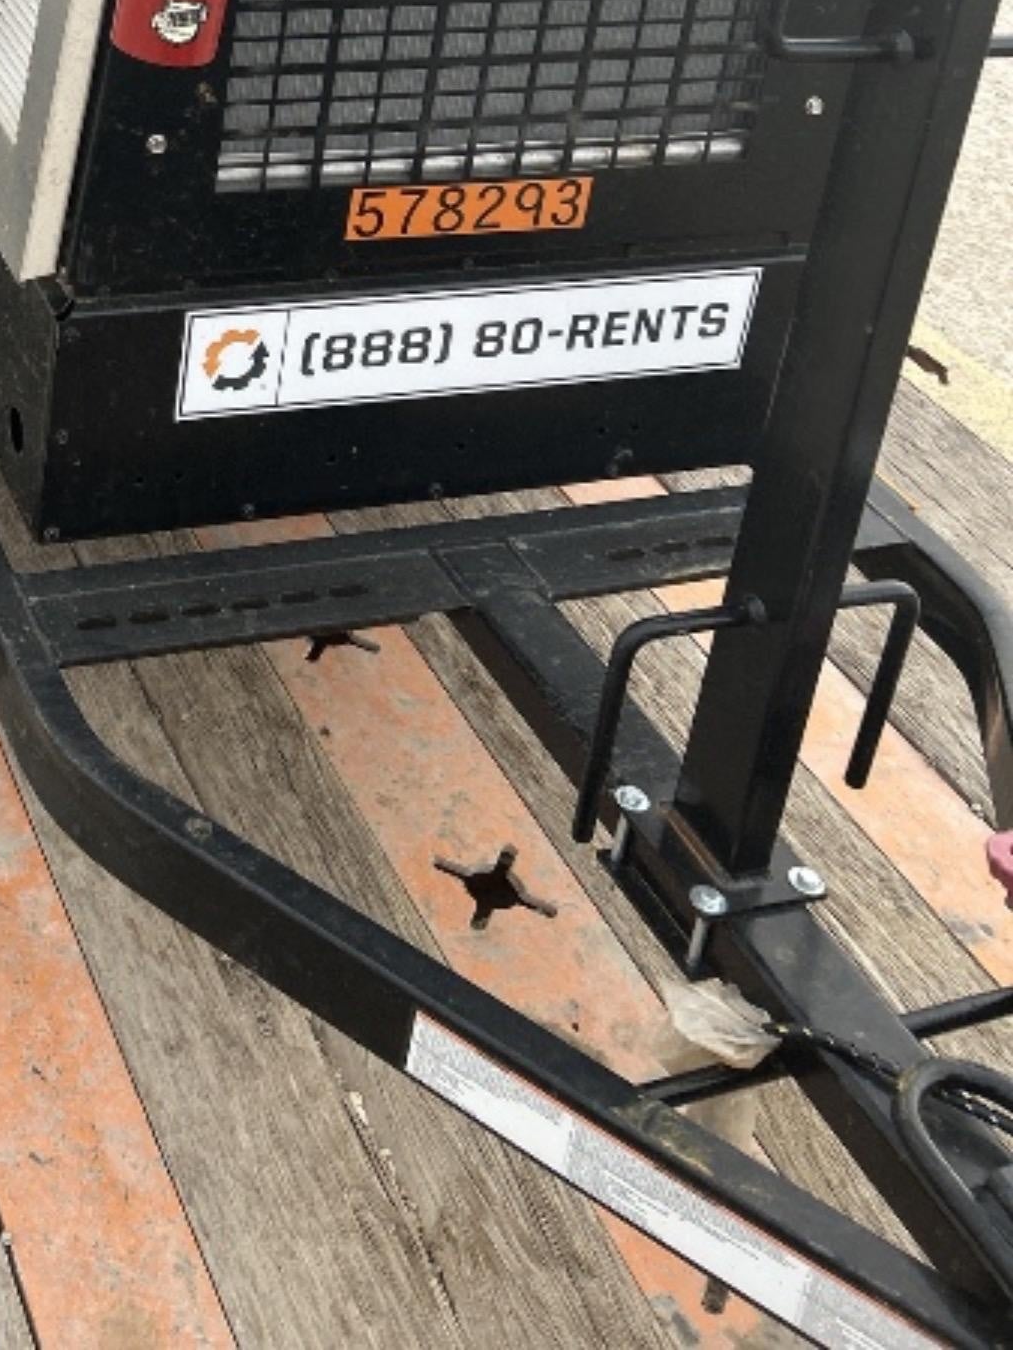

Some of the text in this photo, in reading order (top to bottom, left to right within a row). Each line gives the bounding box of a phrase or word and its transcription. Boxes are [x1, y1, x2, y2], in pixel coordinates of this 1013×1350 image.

[351, 178, 584, 238] 578293
[299, 301, 731, 378] (888) 80-RENTS
